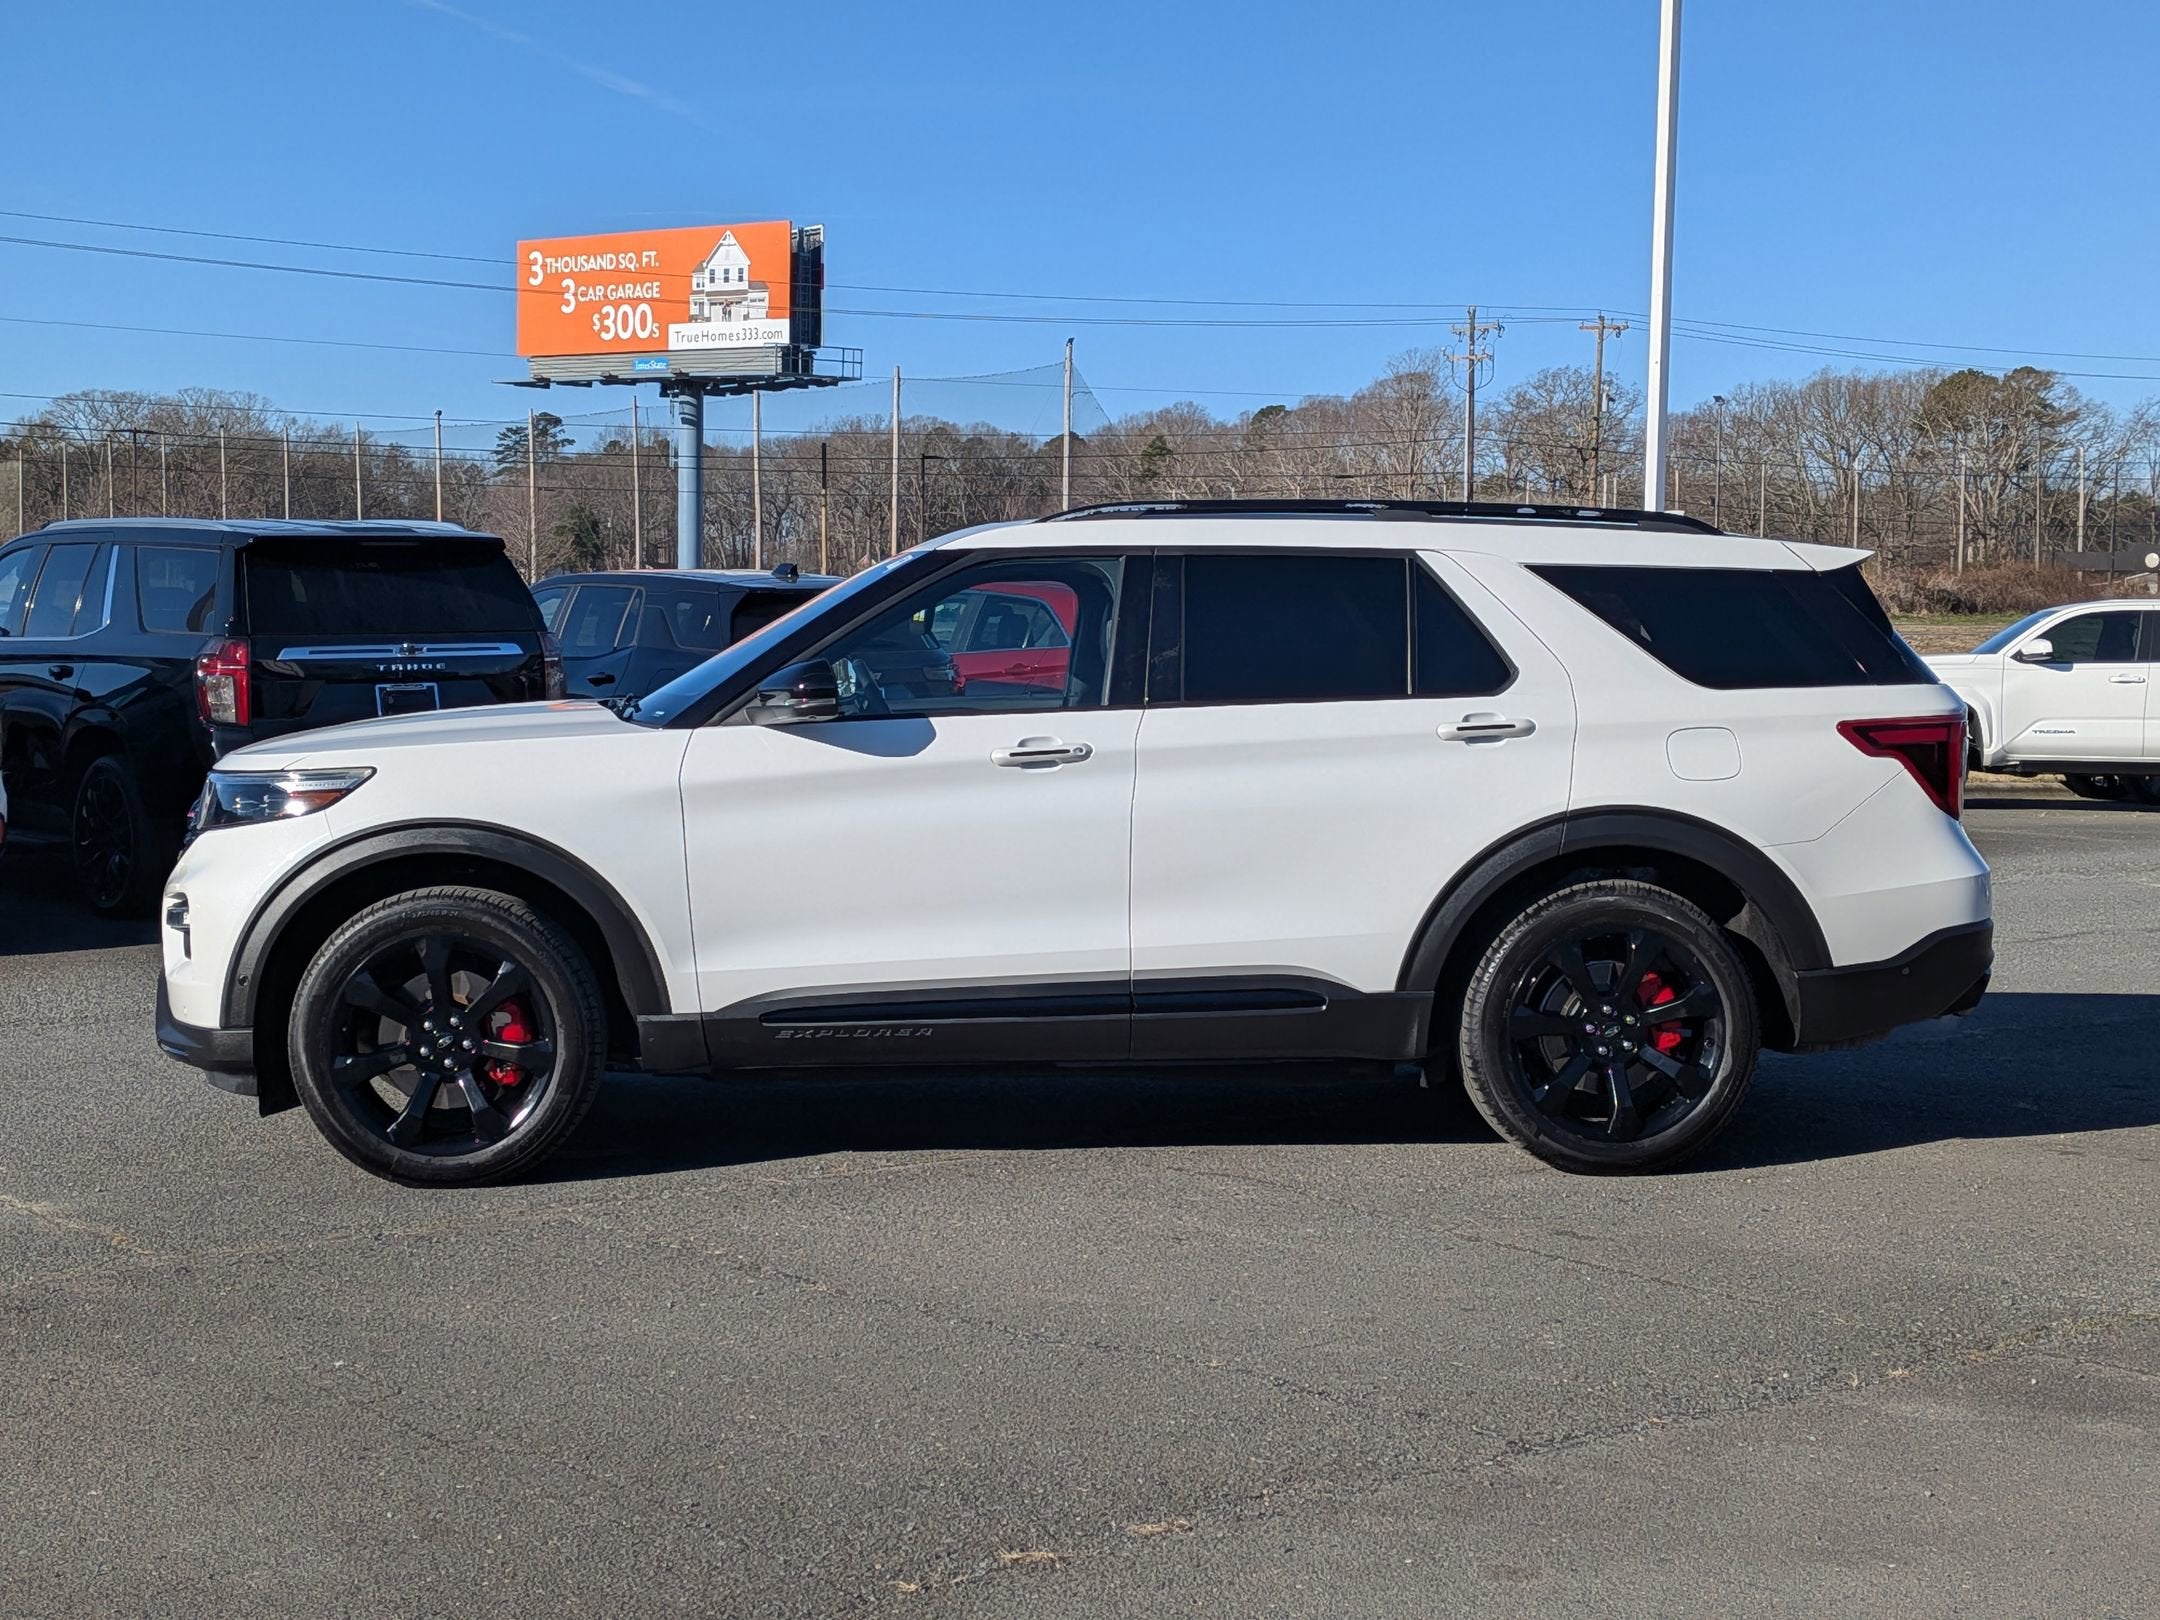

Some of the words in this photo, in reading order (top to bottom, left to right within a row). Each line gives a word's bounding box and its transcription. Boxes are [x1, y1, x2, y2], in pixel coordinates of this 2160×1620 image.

[528, 250, 544, 286] 3
[545, 253, 617, 274] THOUSAND
[618, 252, 639, 272] SQ.
[642, 251, 660, 268] FT.
[560, 278, 576, 314] 3
[577, 285, 605, 302] CAR
[607, 282, 661, 300] GARAGE
[674, 327, 783, 343] TrueHomes333.com
[376, 662, 446, 672] TAHOE
[775, 1027, 934, 1039] EXPLORER
